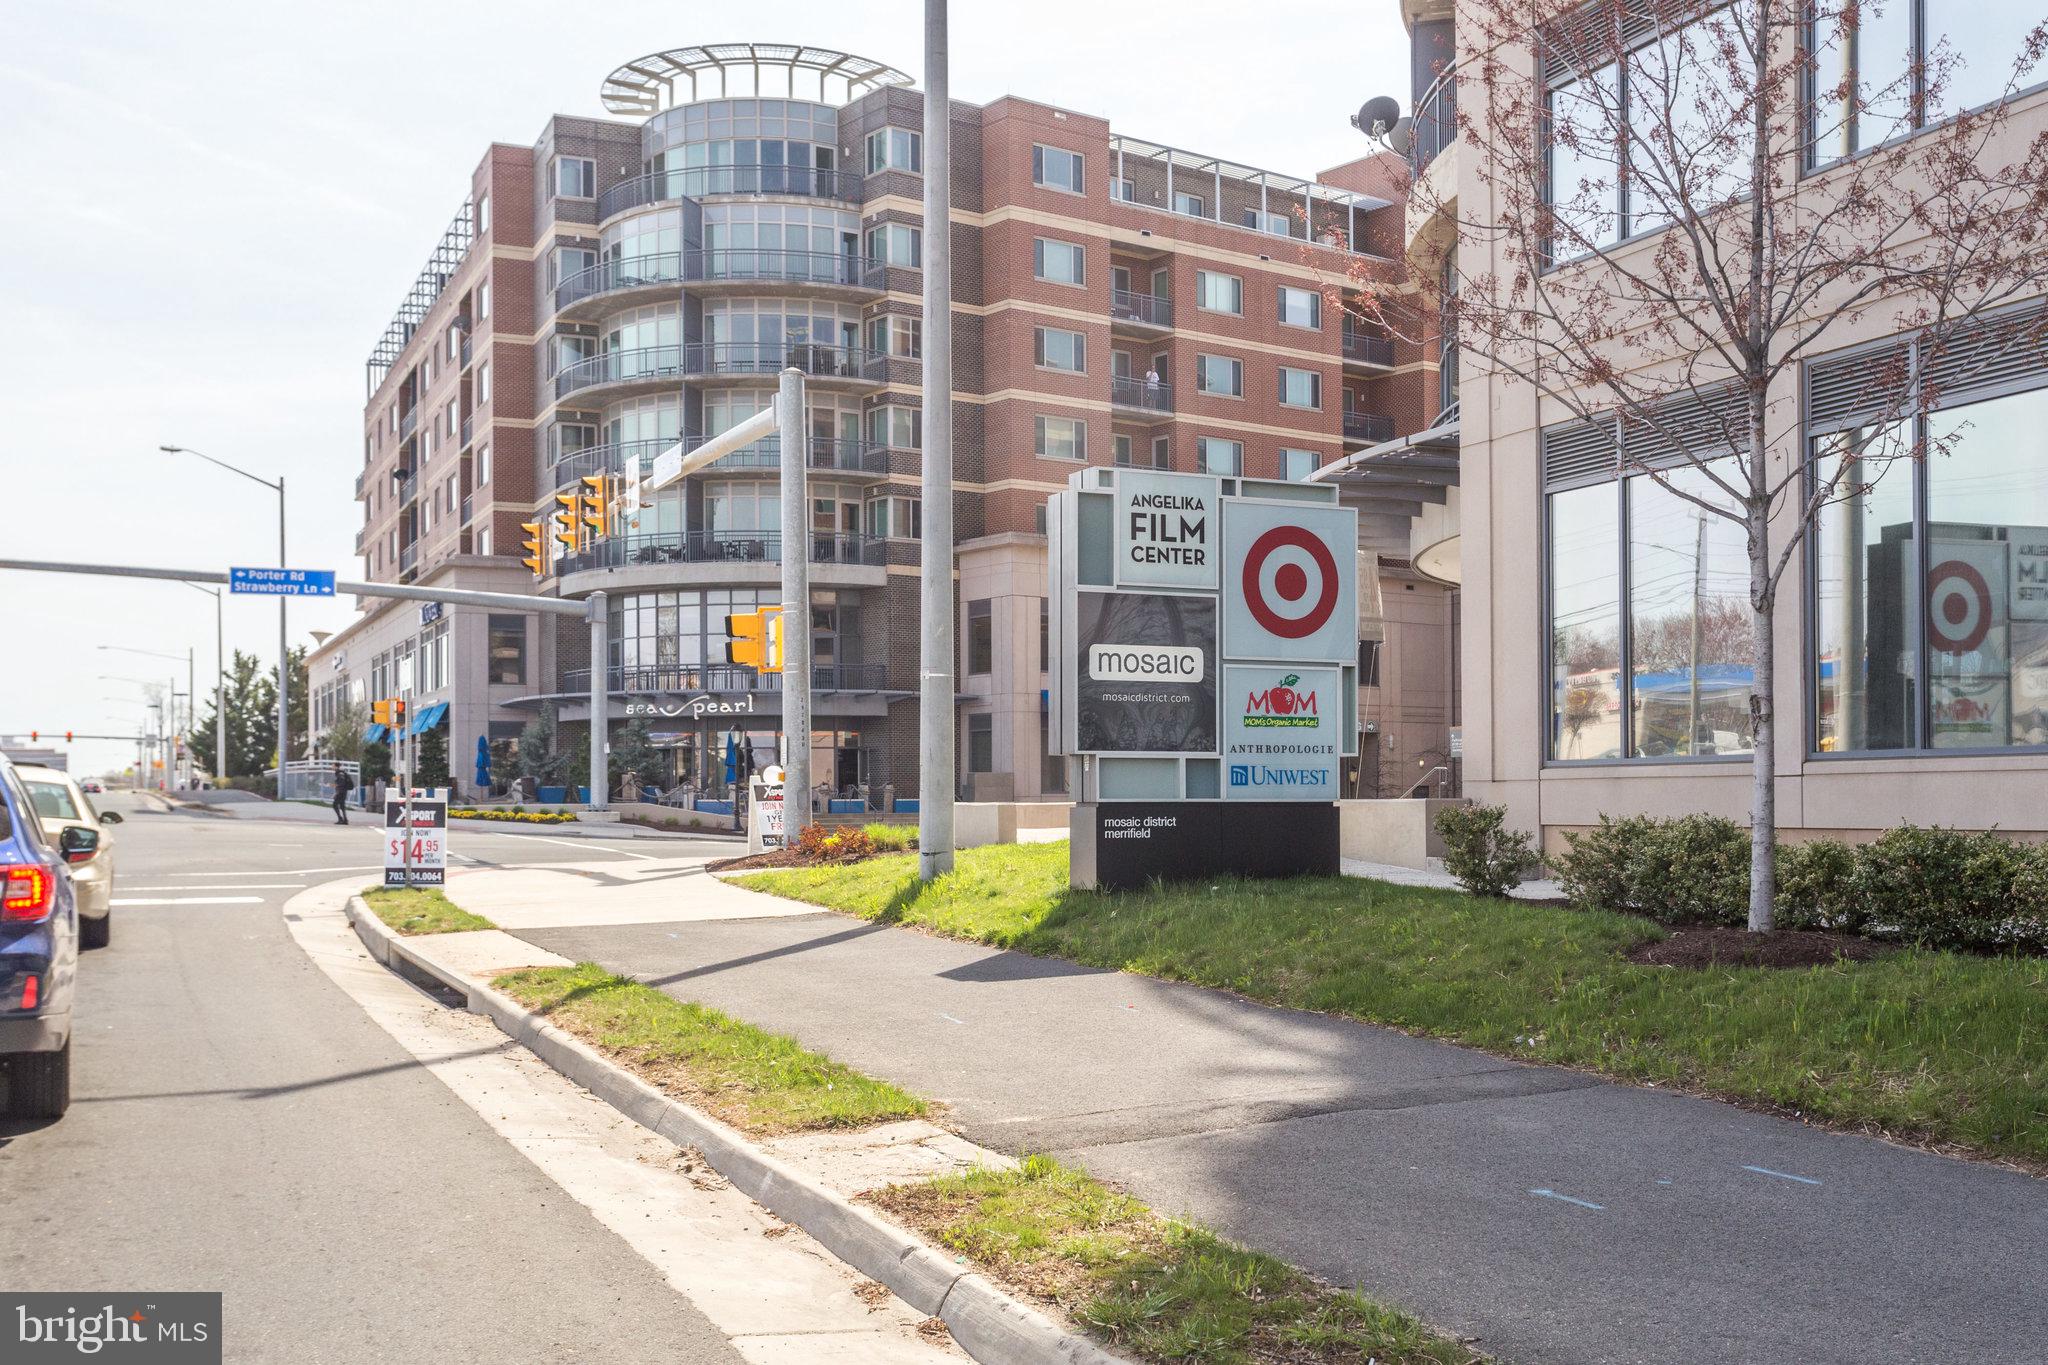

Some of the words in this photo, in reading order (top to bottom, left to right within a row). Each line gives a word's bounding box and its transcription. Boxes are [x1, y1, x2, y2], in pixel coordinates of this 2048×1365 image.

[1131, 494, 1205, 511] ANGELIKA
[1131, 512, 1205, 544] FILM
[1131, 545, 1205, 566] CENTER
[248, 570, 286, 580] Porter
[290, 571, 305, 581] Rd
[234, 582, 299, 594] Strawberry
[304, 584, 318, 593] Ln
[1098, 652, 1195, 674] mosaic
[1102, 692, 1190, 703] mosaicdistrict.com
[625, 704, 658, 715] sea
[693, 694, 754, 720] pearl
[1267, 717, 1292, 728] Organic
[1292, 718, 1318, 727] Market
[1230, 744, 1334, 754] ANTHROPOLOGIE
[1250, 765, 1329, 785] UNIWEST
[1104, 816, 1141, 827] mosaic
[1143, 816, 1177, 827] district
[1104, 828, 1151, 838] merrifield
[389, 871, 442, 881] 703.04.0064
